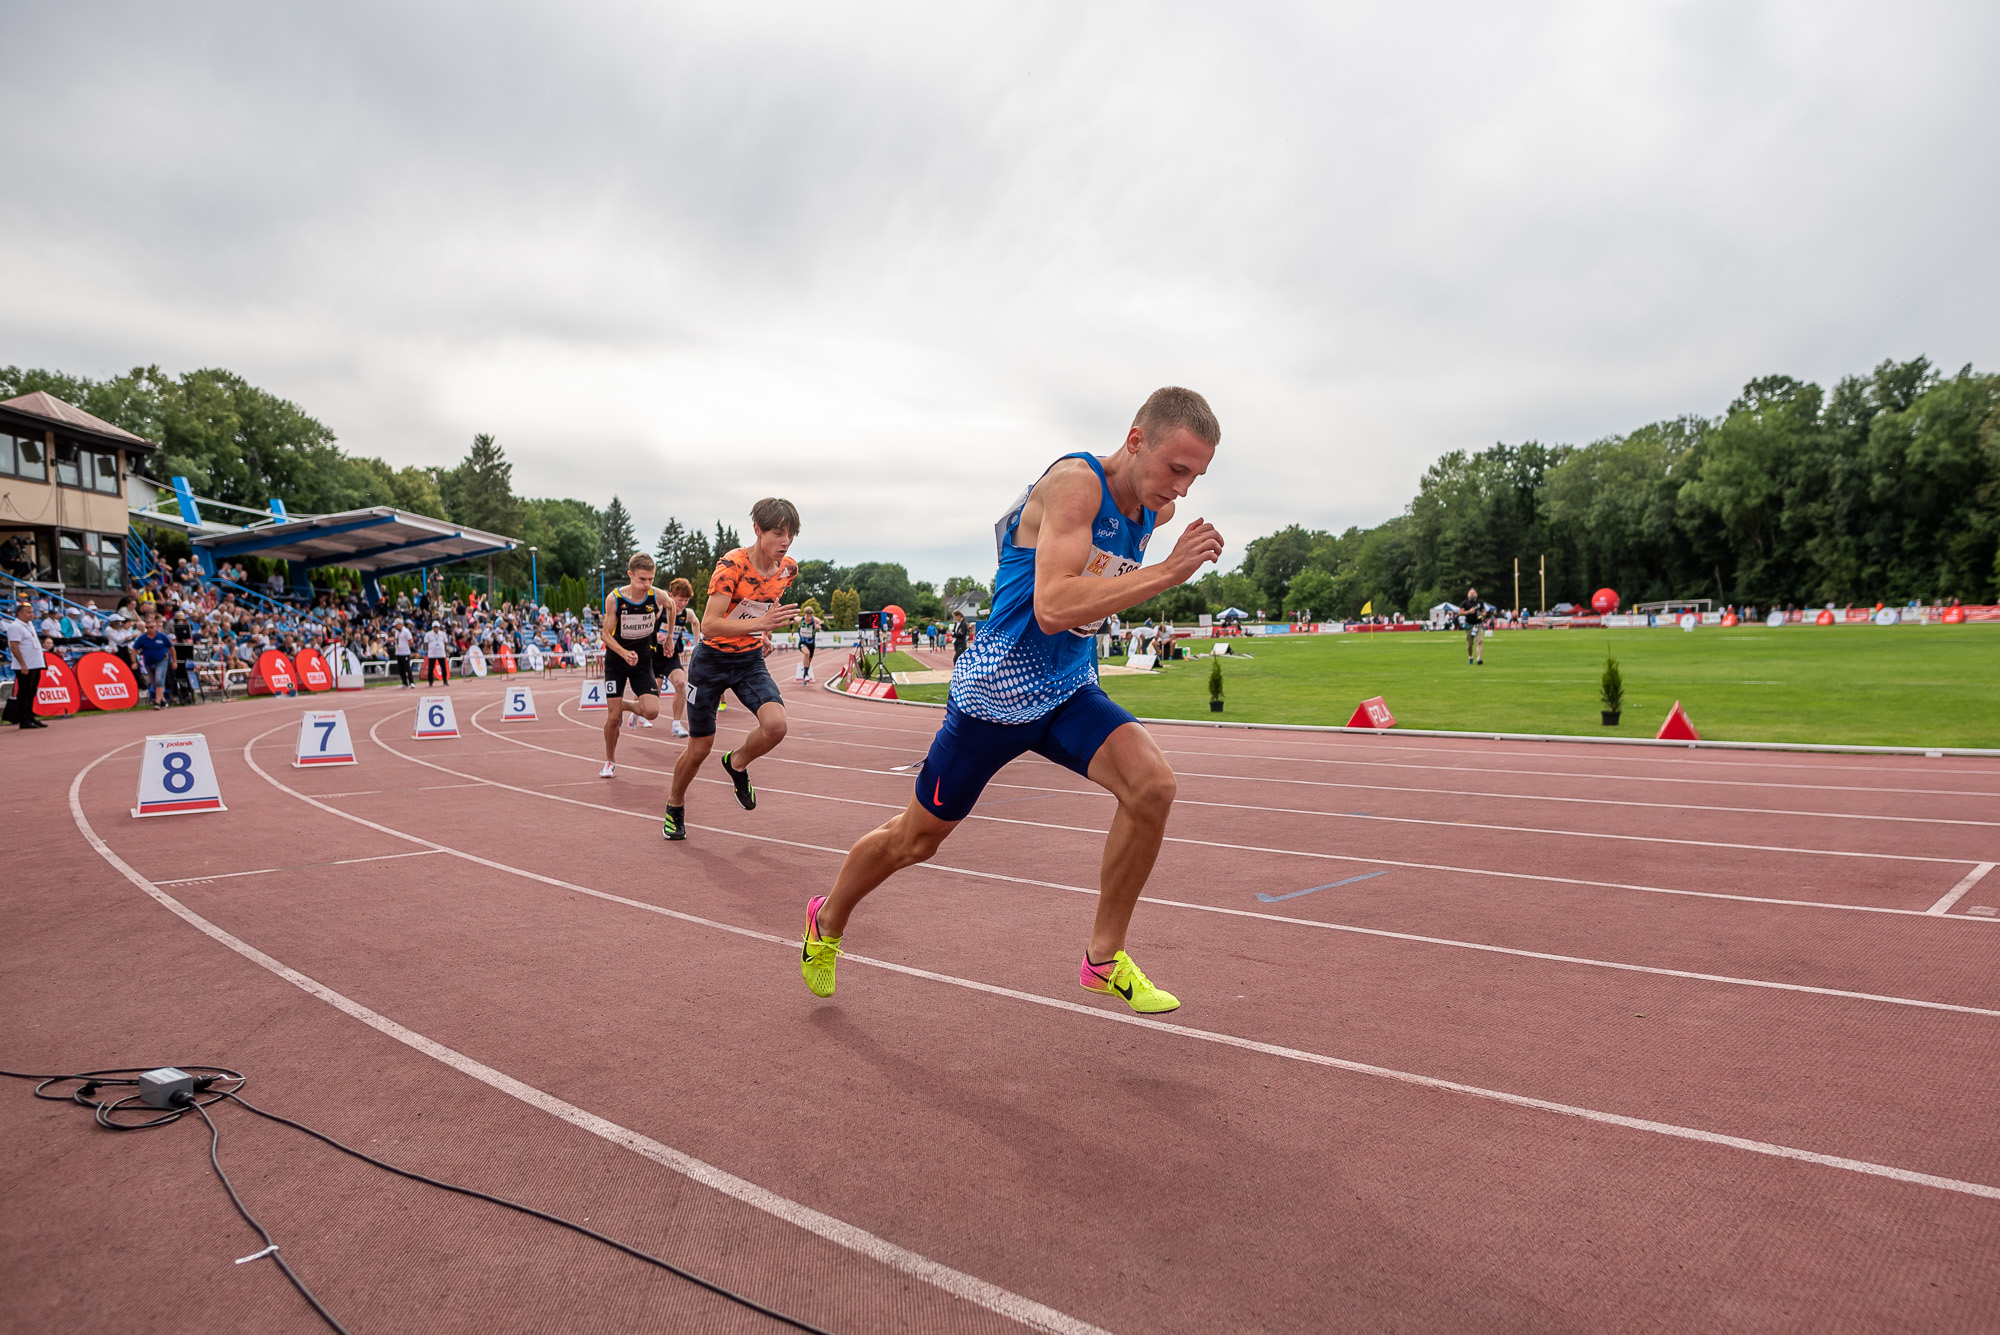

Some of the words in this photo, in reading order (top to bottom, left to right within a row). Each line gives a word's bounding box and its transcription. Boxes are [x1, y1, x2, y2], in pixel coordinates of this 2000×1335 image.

[39, 689, 68, 701] ORLEN
[98, 686, 127, 697] ORLEN
[587, 686, 600, 702] 4
[606, 681, 614, 693] 6
[687, 684, 694, 700] 7
[513, 693, 526, 712] 5
[428, 705, 445, 727] 6
[1368, 703, 1393, 725] PZLA
[166, 740, 193, 748] polanik
[314, 721, 336, 752] 7
[162, 751, 195, 794] 8
